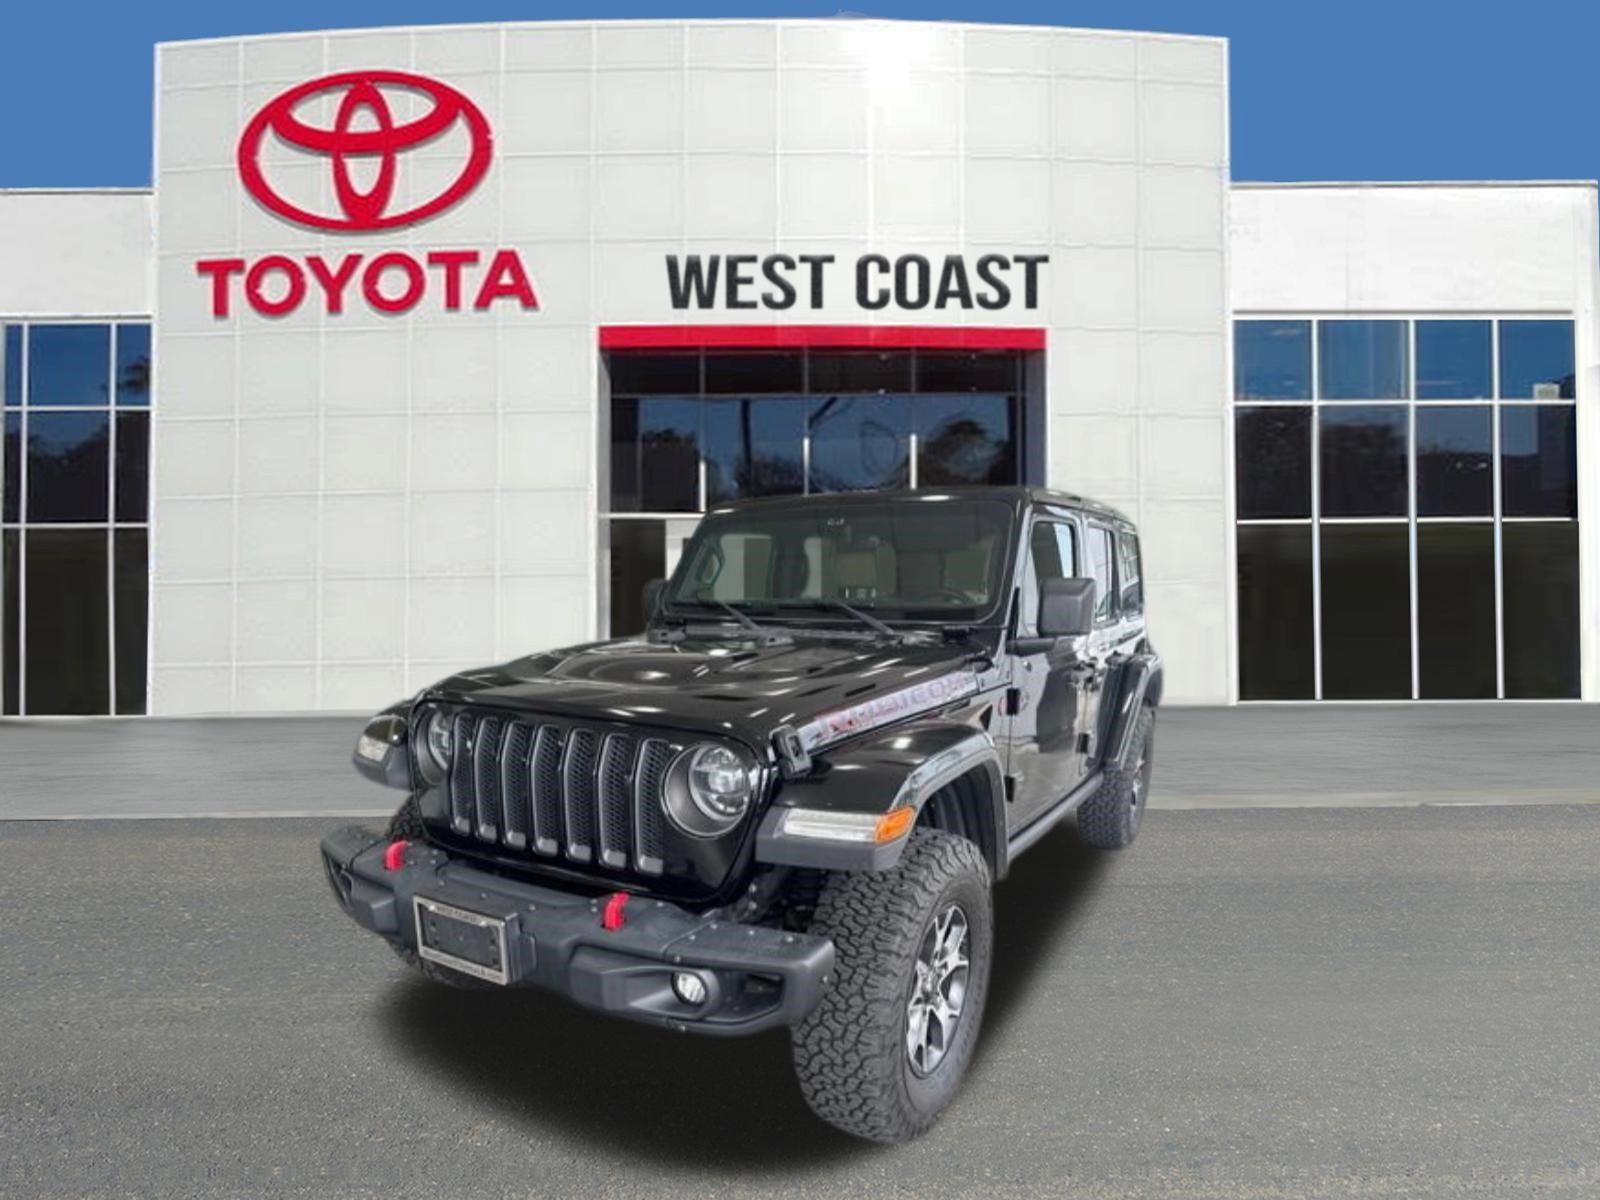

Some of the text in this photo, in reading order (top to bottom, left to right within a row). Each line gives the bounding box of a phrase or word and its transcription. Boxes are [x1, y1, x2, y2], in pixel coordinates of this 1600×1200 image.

[196, 249, 538, 316] TOYOTA
[666, 254, 1050, 310] WEST COAST
